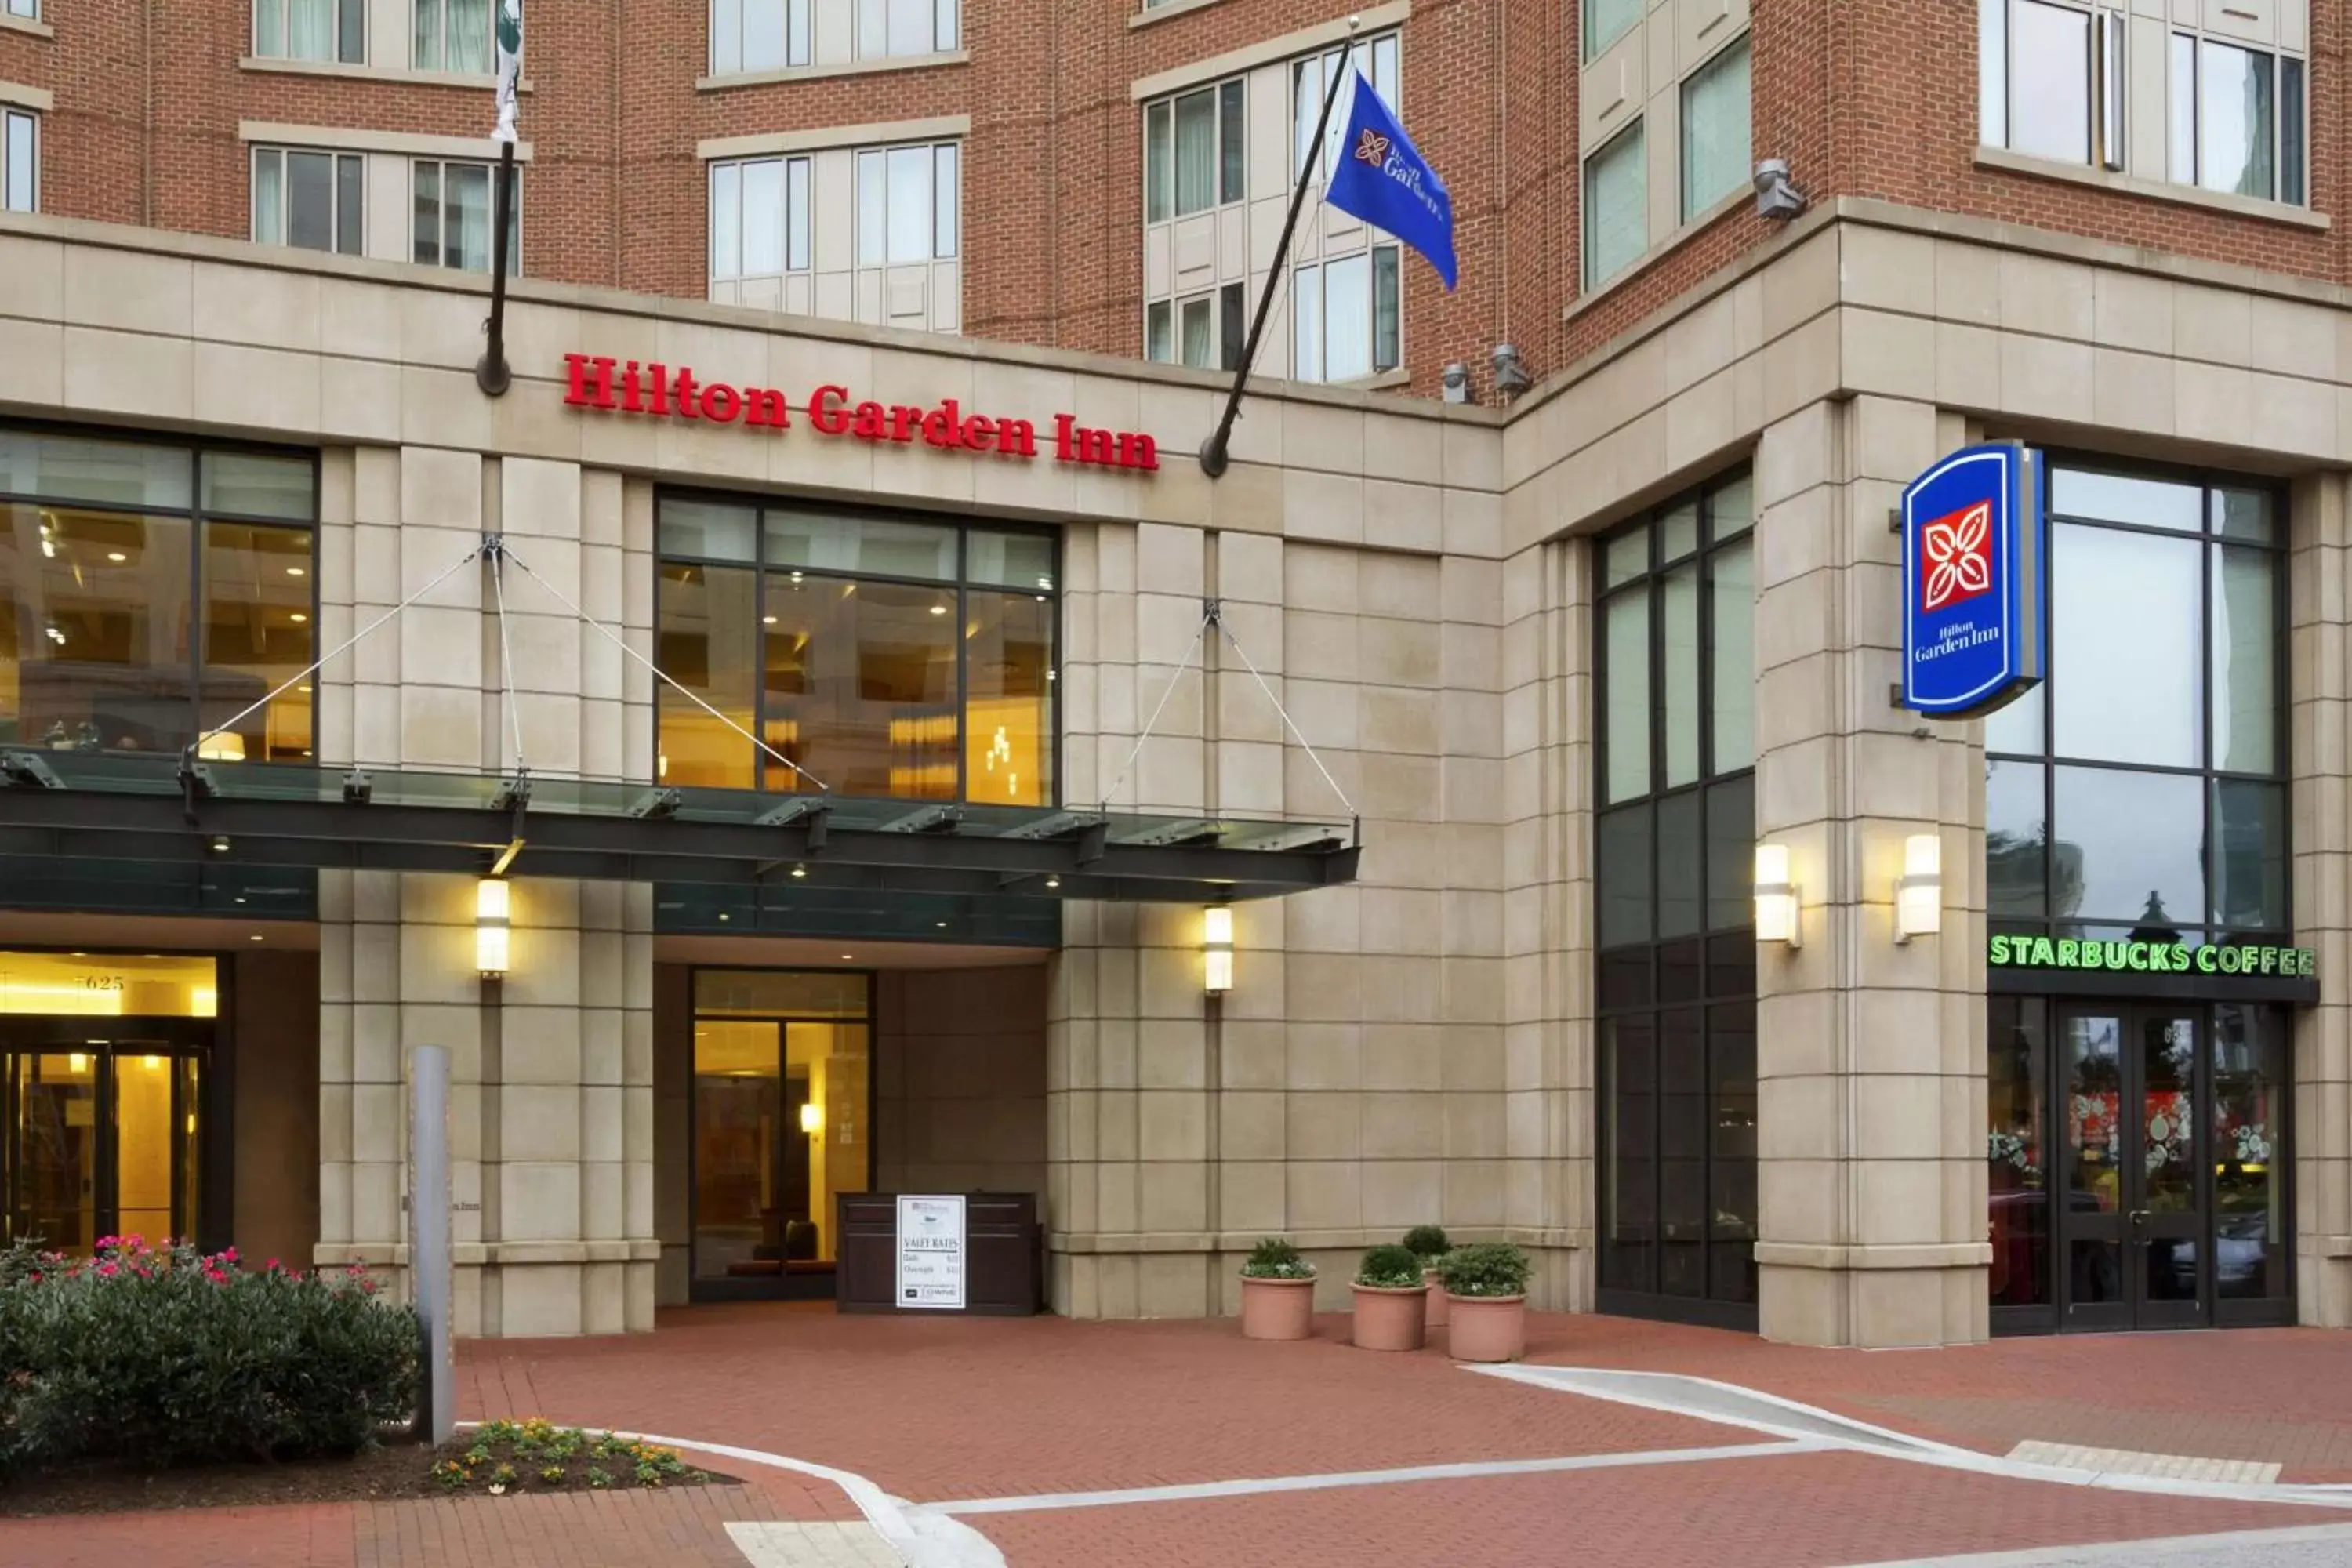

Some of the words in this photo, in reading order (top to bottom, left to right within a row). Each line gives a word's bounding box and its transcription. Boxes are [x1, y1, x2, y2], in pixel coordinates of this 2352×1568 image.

[564, 353, 790, 429] Hilton
[808, 384, 1037, 456] Garden
[1054, 413, 1160, 470] Inn
[1915, 636, 1969, 662] Garden
[1972, 626, 1998, 645] Inn
[1990, 935, 2190, 971] STARBUCKS
[2196, 945, 2314, 975] COFFEE
[86, 975, 124, 990] 625
